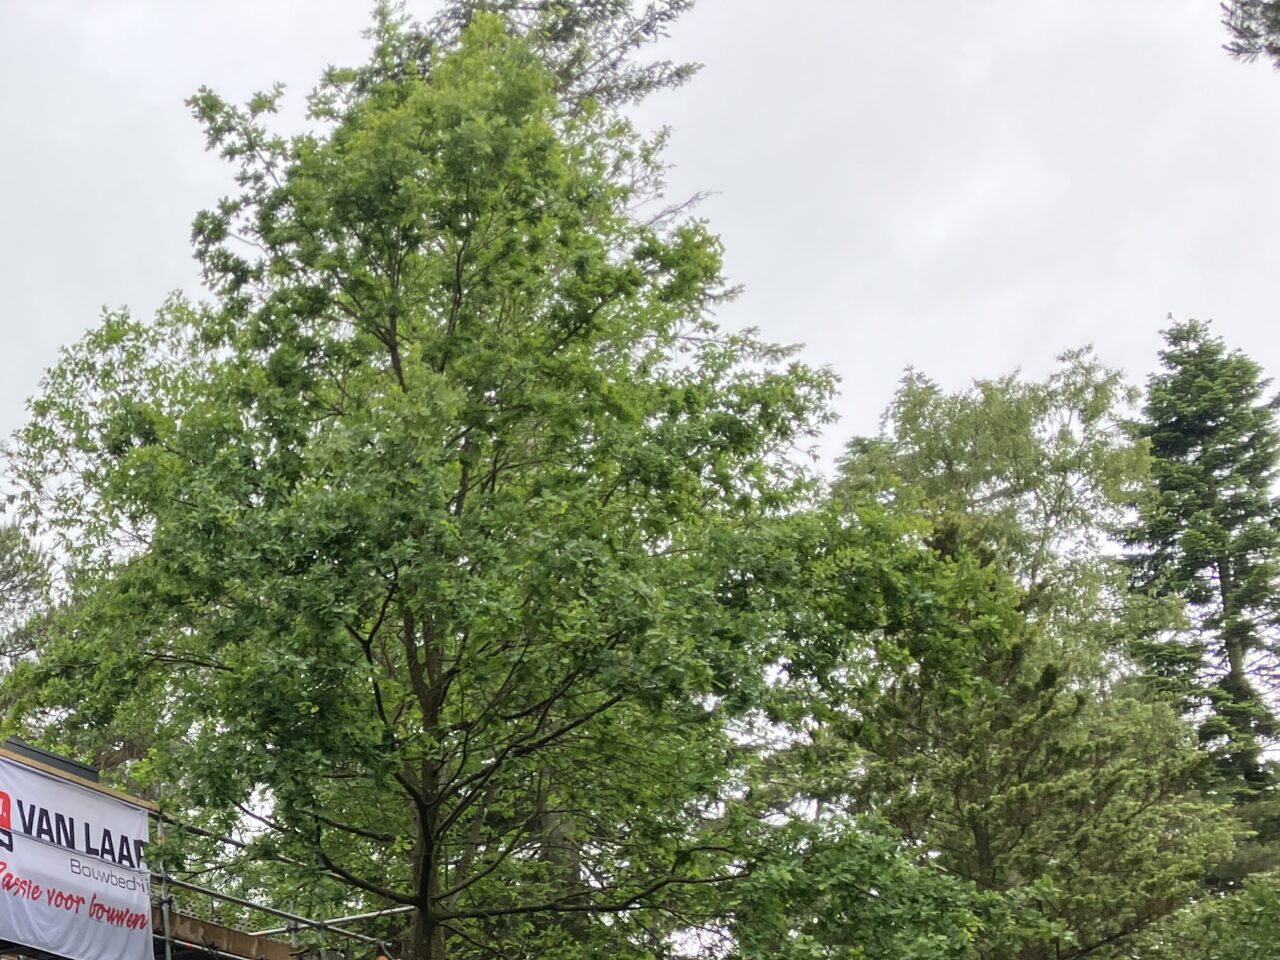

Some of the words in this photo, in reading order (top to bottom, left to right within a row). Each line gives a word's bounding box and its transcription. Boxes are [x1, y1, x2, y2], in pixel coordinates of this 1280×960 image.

[16, 799, 75, 850] VAN
[47, 887, 86, 914] voor
[89, 892, 148, 930] bouwen
